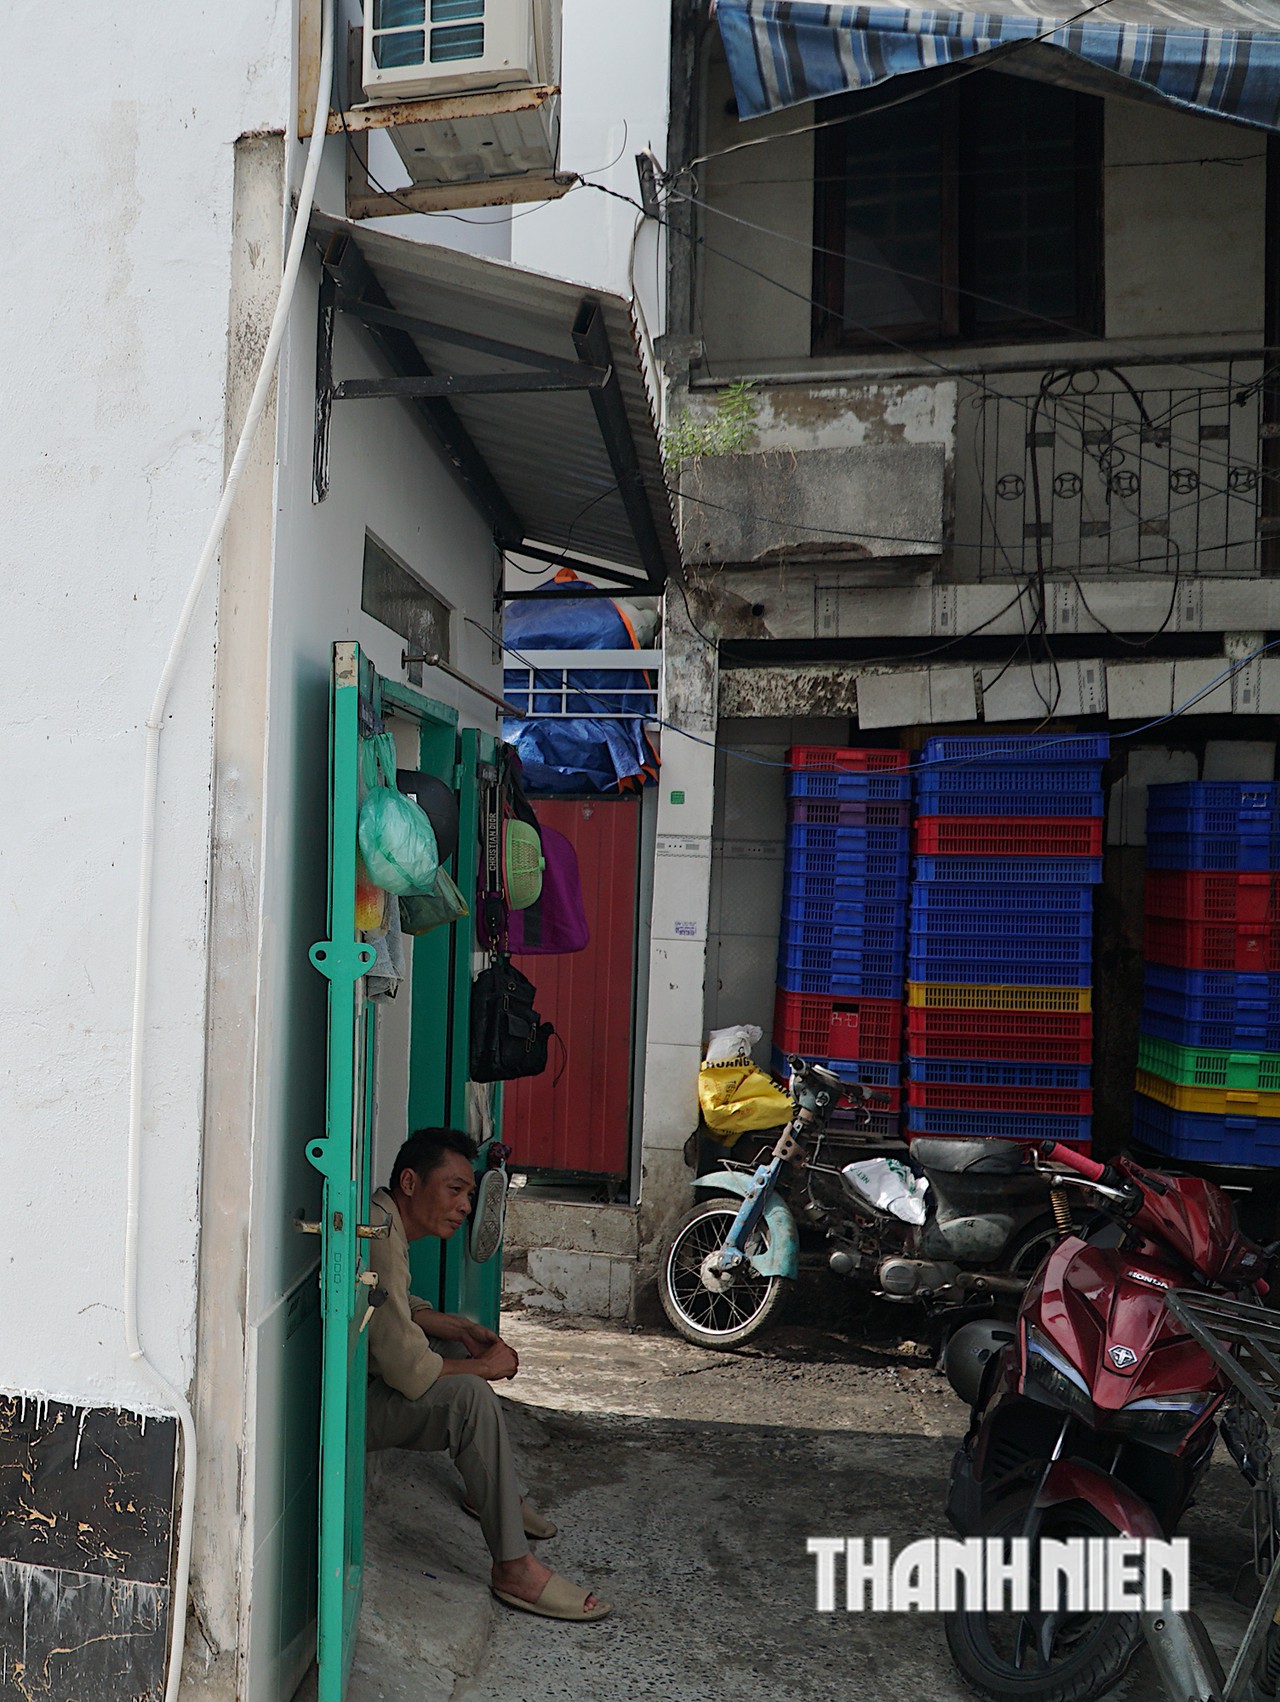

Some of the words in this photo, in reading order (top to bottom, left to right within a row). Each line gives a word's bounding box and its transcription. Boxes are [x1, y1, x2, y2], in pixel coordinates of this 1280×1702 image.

[488, 812, 497, 831] DIOR
[488, 832, 497, 872] CHRISTIAN
[1127, 1270, 1169, 1290] HONDA
